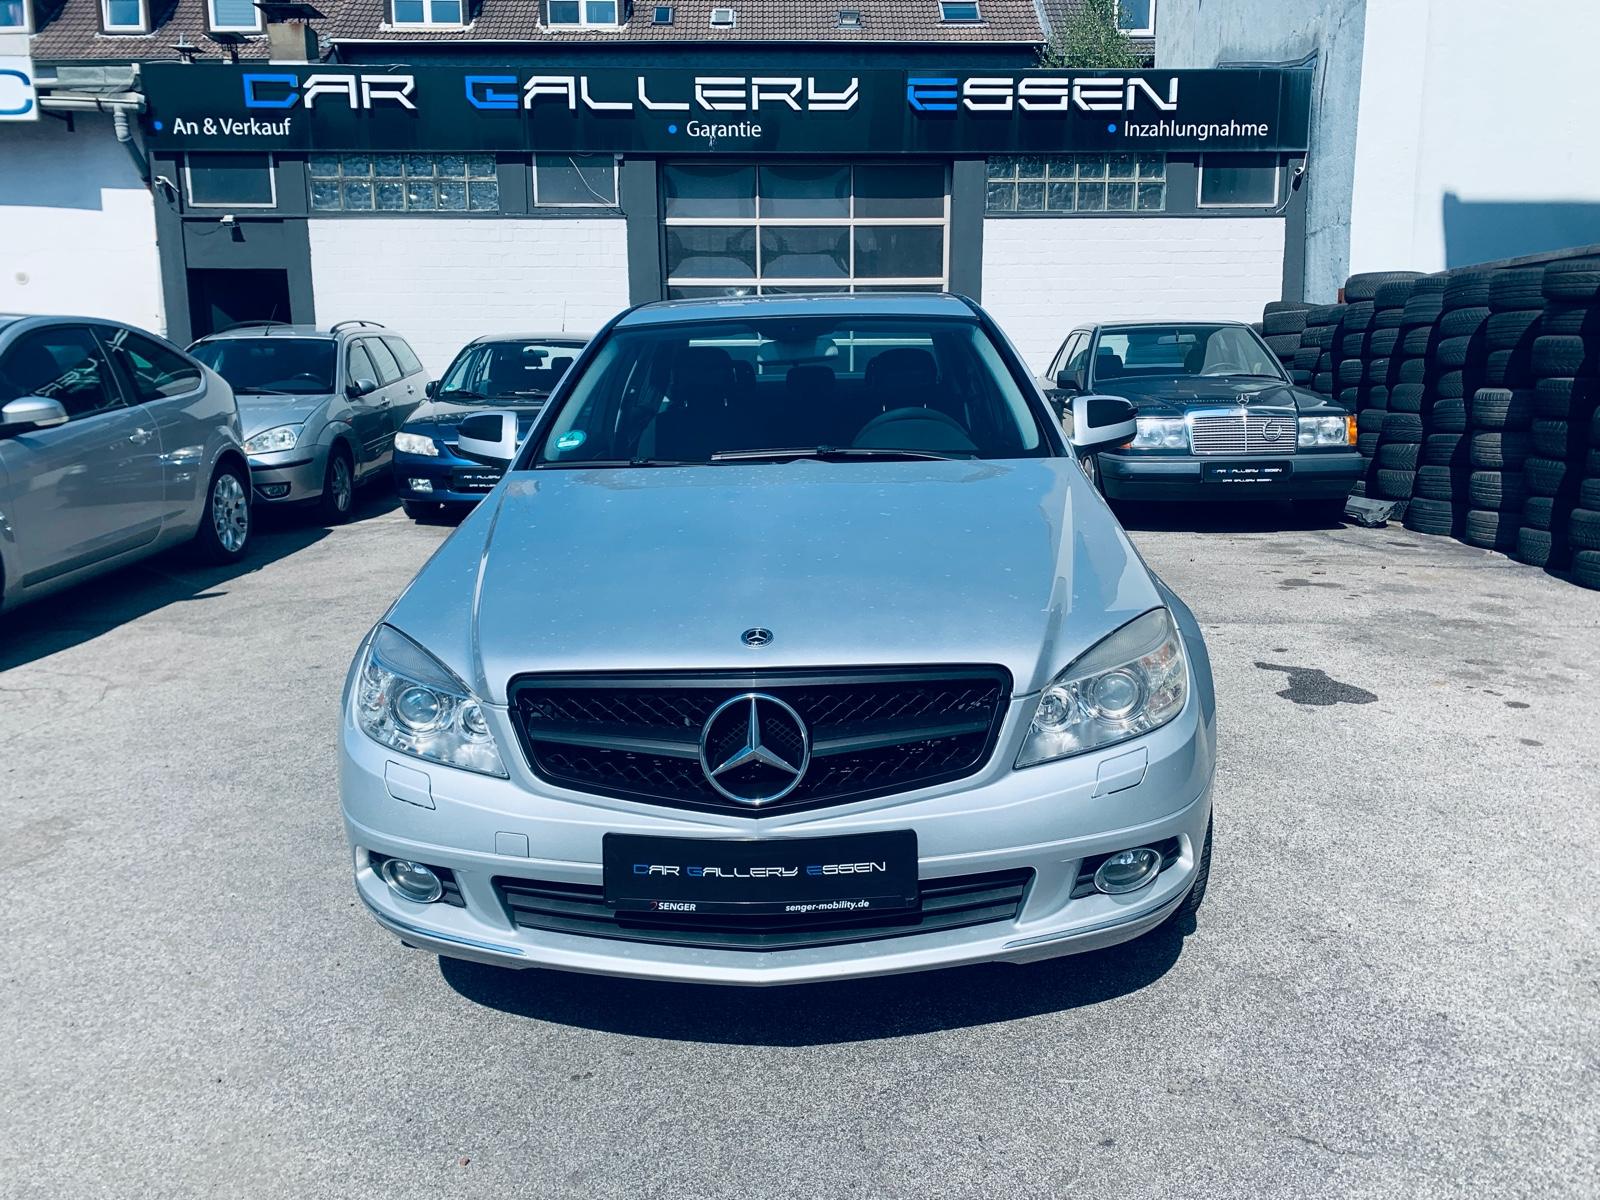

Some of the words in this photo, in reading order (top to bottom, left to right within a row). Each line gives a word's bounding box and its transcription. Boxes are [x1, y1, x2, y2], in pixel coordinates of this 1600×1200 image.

[242, 73, 417, 110] CAR
[464, 75, 859, 111] GALLERY
[907, 76, 1179, 111] ESSEN
[173, 117, 199, 135] An
[202, 117, 217, 136] &
[218, 117, 292, 136] Verkauf
[686, 120, 762, 137] Garantie
[1124, 120, 1269, 141] Inzahlungnahme
[633, 864, 680, 876] CAR
[686, 866, 798, 878] GALLERY
[806, 861, 887, 876] ESSEN
[657, 900, 697, 912] SENGER
[784, 900, 871, 913] senger-mobility.de
